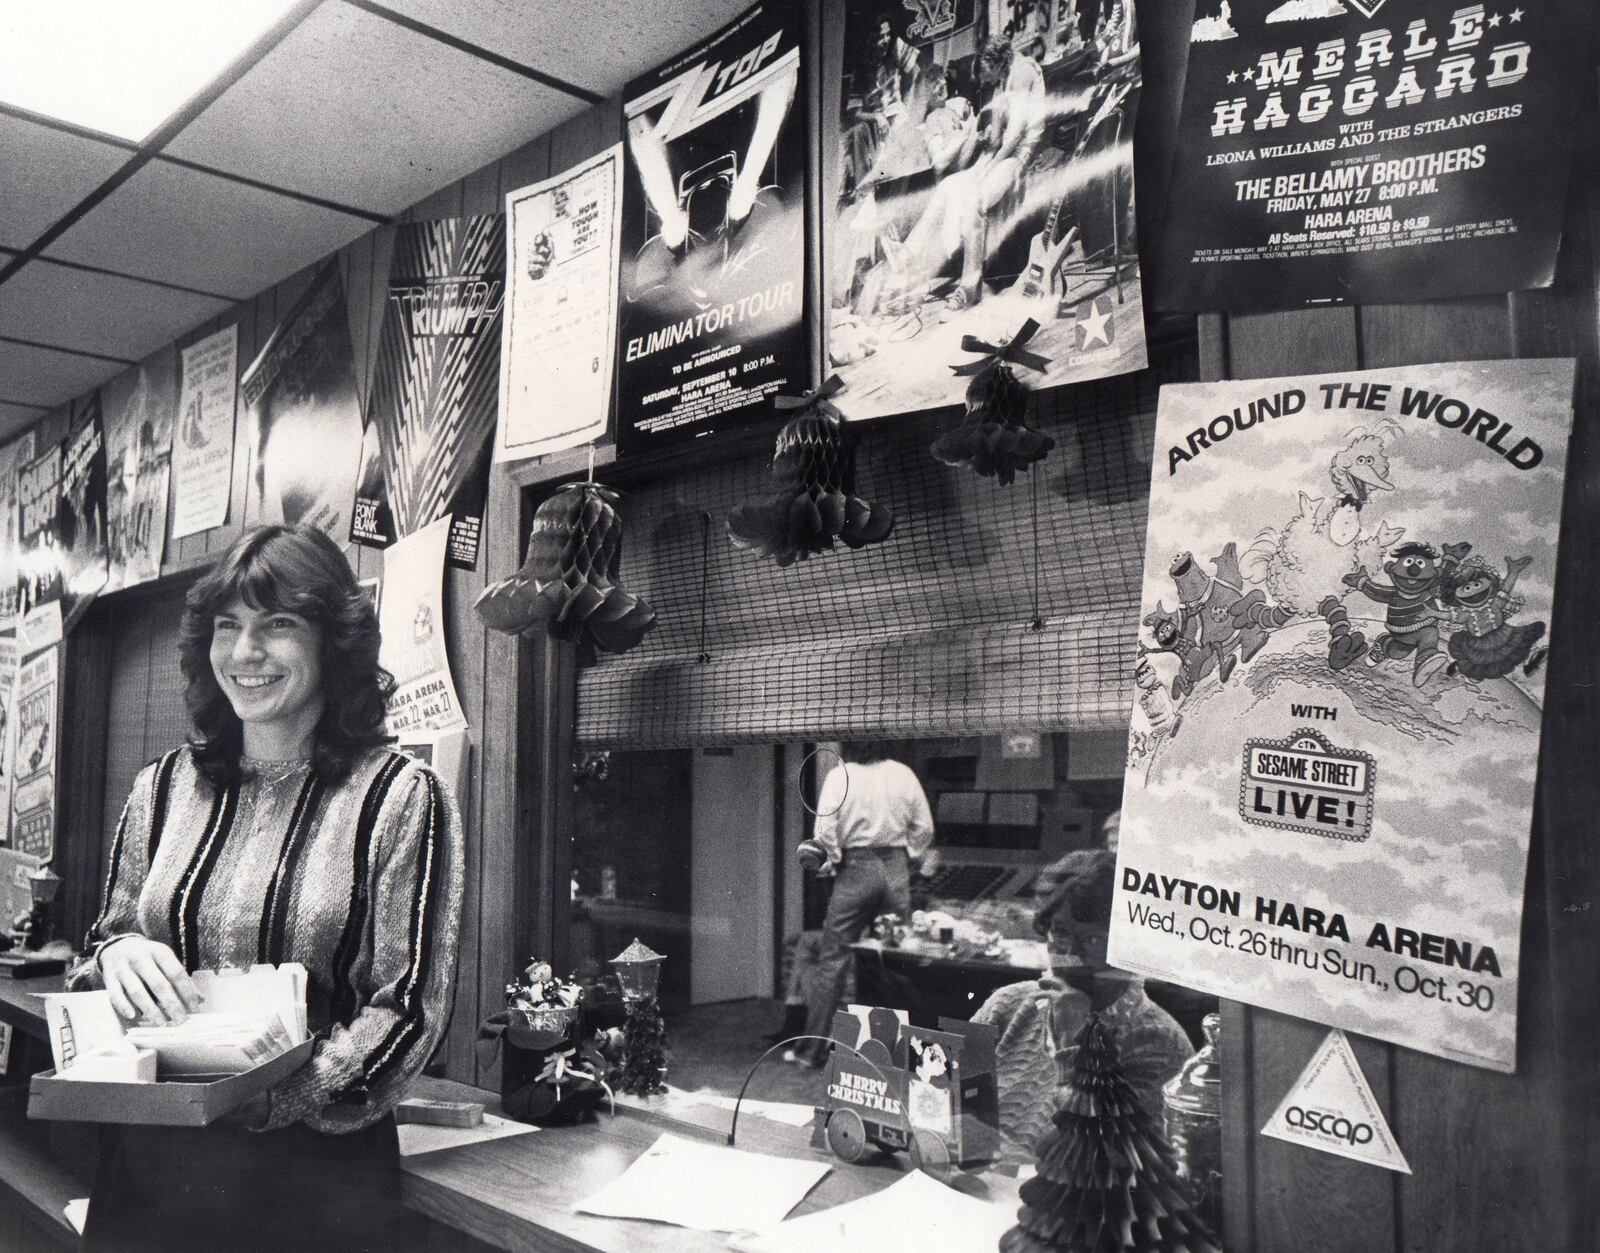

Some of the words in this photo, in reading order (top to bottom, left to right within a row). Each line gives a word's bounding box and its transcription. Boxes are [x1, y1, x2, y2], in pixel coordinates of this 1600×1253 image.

[713, 29, 784, 95] TOP
[1256, 4, 1485, 91] MERLE
[1211, 40, 1531, 137] HAGGARD
[1207, 151, 1256, 166] LEONA
[1259, 138, 1335, 162] WILLIAMS
[1339, 133, 1375, 149] AND
[1377, 125, 1411, 142] THE
[1413, 104, 1523, 136] STRANGERS
[1339, 120, 1374, 135] WITH
[1235, 178, 1271, 200] THE
[1274, 164, 1368, 197] BELLAMY
[1371, 144, 1487, 185] BROTHERS
[579, 200, 597, 215] HOW
[1266, 195, 1318, 213] FRIDAY,
[1320, 190, 1353, 208] MAY
[1354, 187, 1371, 203] 27
[1379, 181, 1406, 201] 8:00
[1408, 177, 1438, 195] P.M.
[572, 211, 598, 229] TOUGH
[578, 224, 590, 234] ARE
[1268, 233, 1281, 245] All
[1282, 232, 1308, 243] Seats
[1309, 226, 1356, 241] Reserved:
[1392, 220, 1401, 232] &
[1305, 210, 1346, 229] HARA
[1347, 205, 1393, 223] ARENA
[573, 229, 597, 246] YOU??
[389, 281, 505, 338] TRIUMPH
[626, 302, 735, 363] ELIMINATOR
[739, 281, 795, 322] TOUR
[672, 365, 682, 374] TO
[683, 361, 693, 371] BE
[694, 344, 742, 367] ANNOUNCED
[642, 386, 680, 405] SATURDAY,
[682, 371, 726, 392] SEPTEMBER
[728, 367, 737, 377] 10
[743, 360, 758, 372] 8:00
[760, 354, 775, 366] P.M.
[681, 389, 703, 402] HARA
[704, 380, 731, 395] ARENA
[1168, 388, 1306, 476] AROUND
[1319, 383, 1392, 411] THE
[1400, 387, 1544, 470] WORLD
[354, 516, 377, 533] BLANK
[415, 680, 445, 700] ARENA
[393, 715, 410, 731] MAR
[410, 704, 421, 723] 22
[423, 704, 441, 718] MAR
[1291, 703, 1337, 721] WITH
[1257, 753, 1309, 780] SESAME
[1311, 760, 1359, 787] STREET
[1254, 786, 1356, 827] LIVE!
[1122, 867, 1242, 917] DAYTON
[1255, 896, 1350, 942] HARA
[1366, 922, 1502, 978] ARENA
[1127, 901, 1185, 938] Wed.,
[1189, 918, 1234, 948] Oct.
[1238, 929, 1266, 957] 26
[1268, 934, 1319, 970] thru
[1321, 949, 1389, 991] Sun.,
[1394, 965, 1453, 1003] Oct.
[1456, 984, 1495, 1012] 30
[827, 1084, 901, 1114] CHRISTMAS
[840, 1072, 888, 1095] MERRY
[1285, 1106, 1373, 1146] ascap
